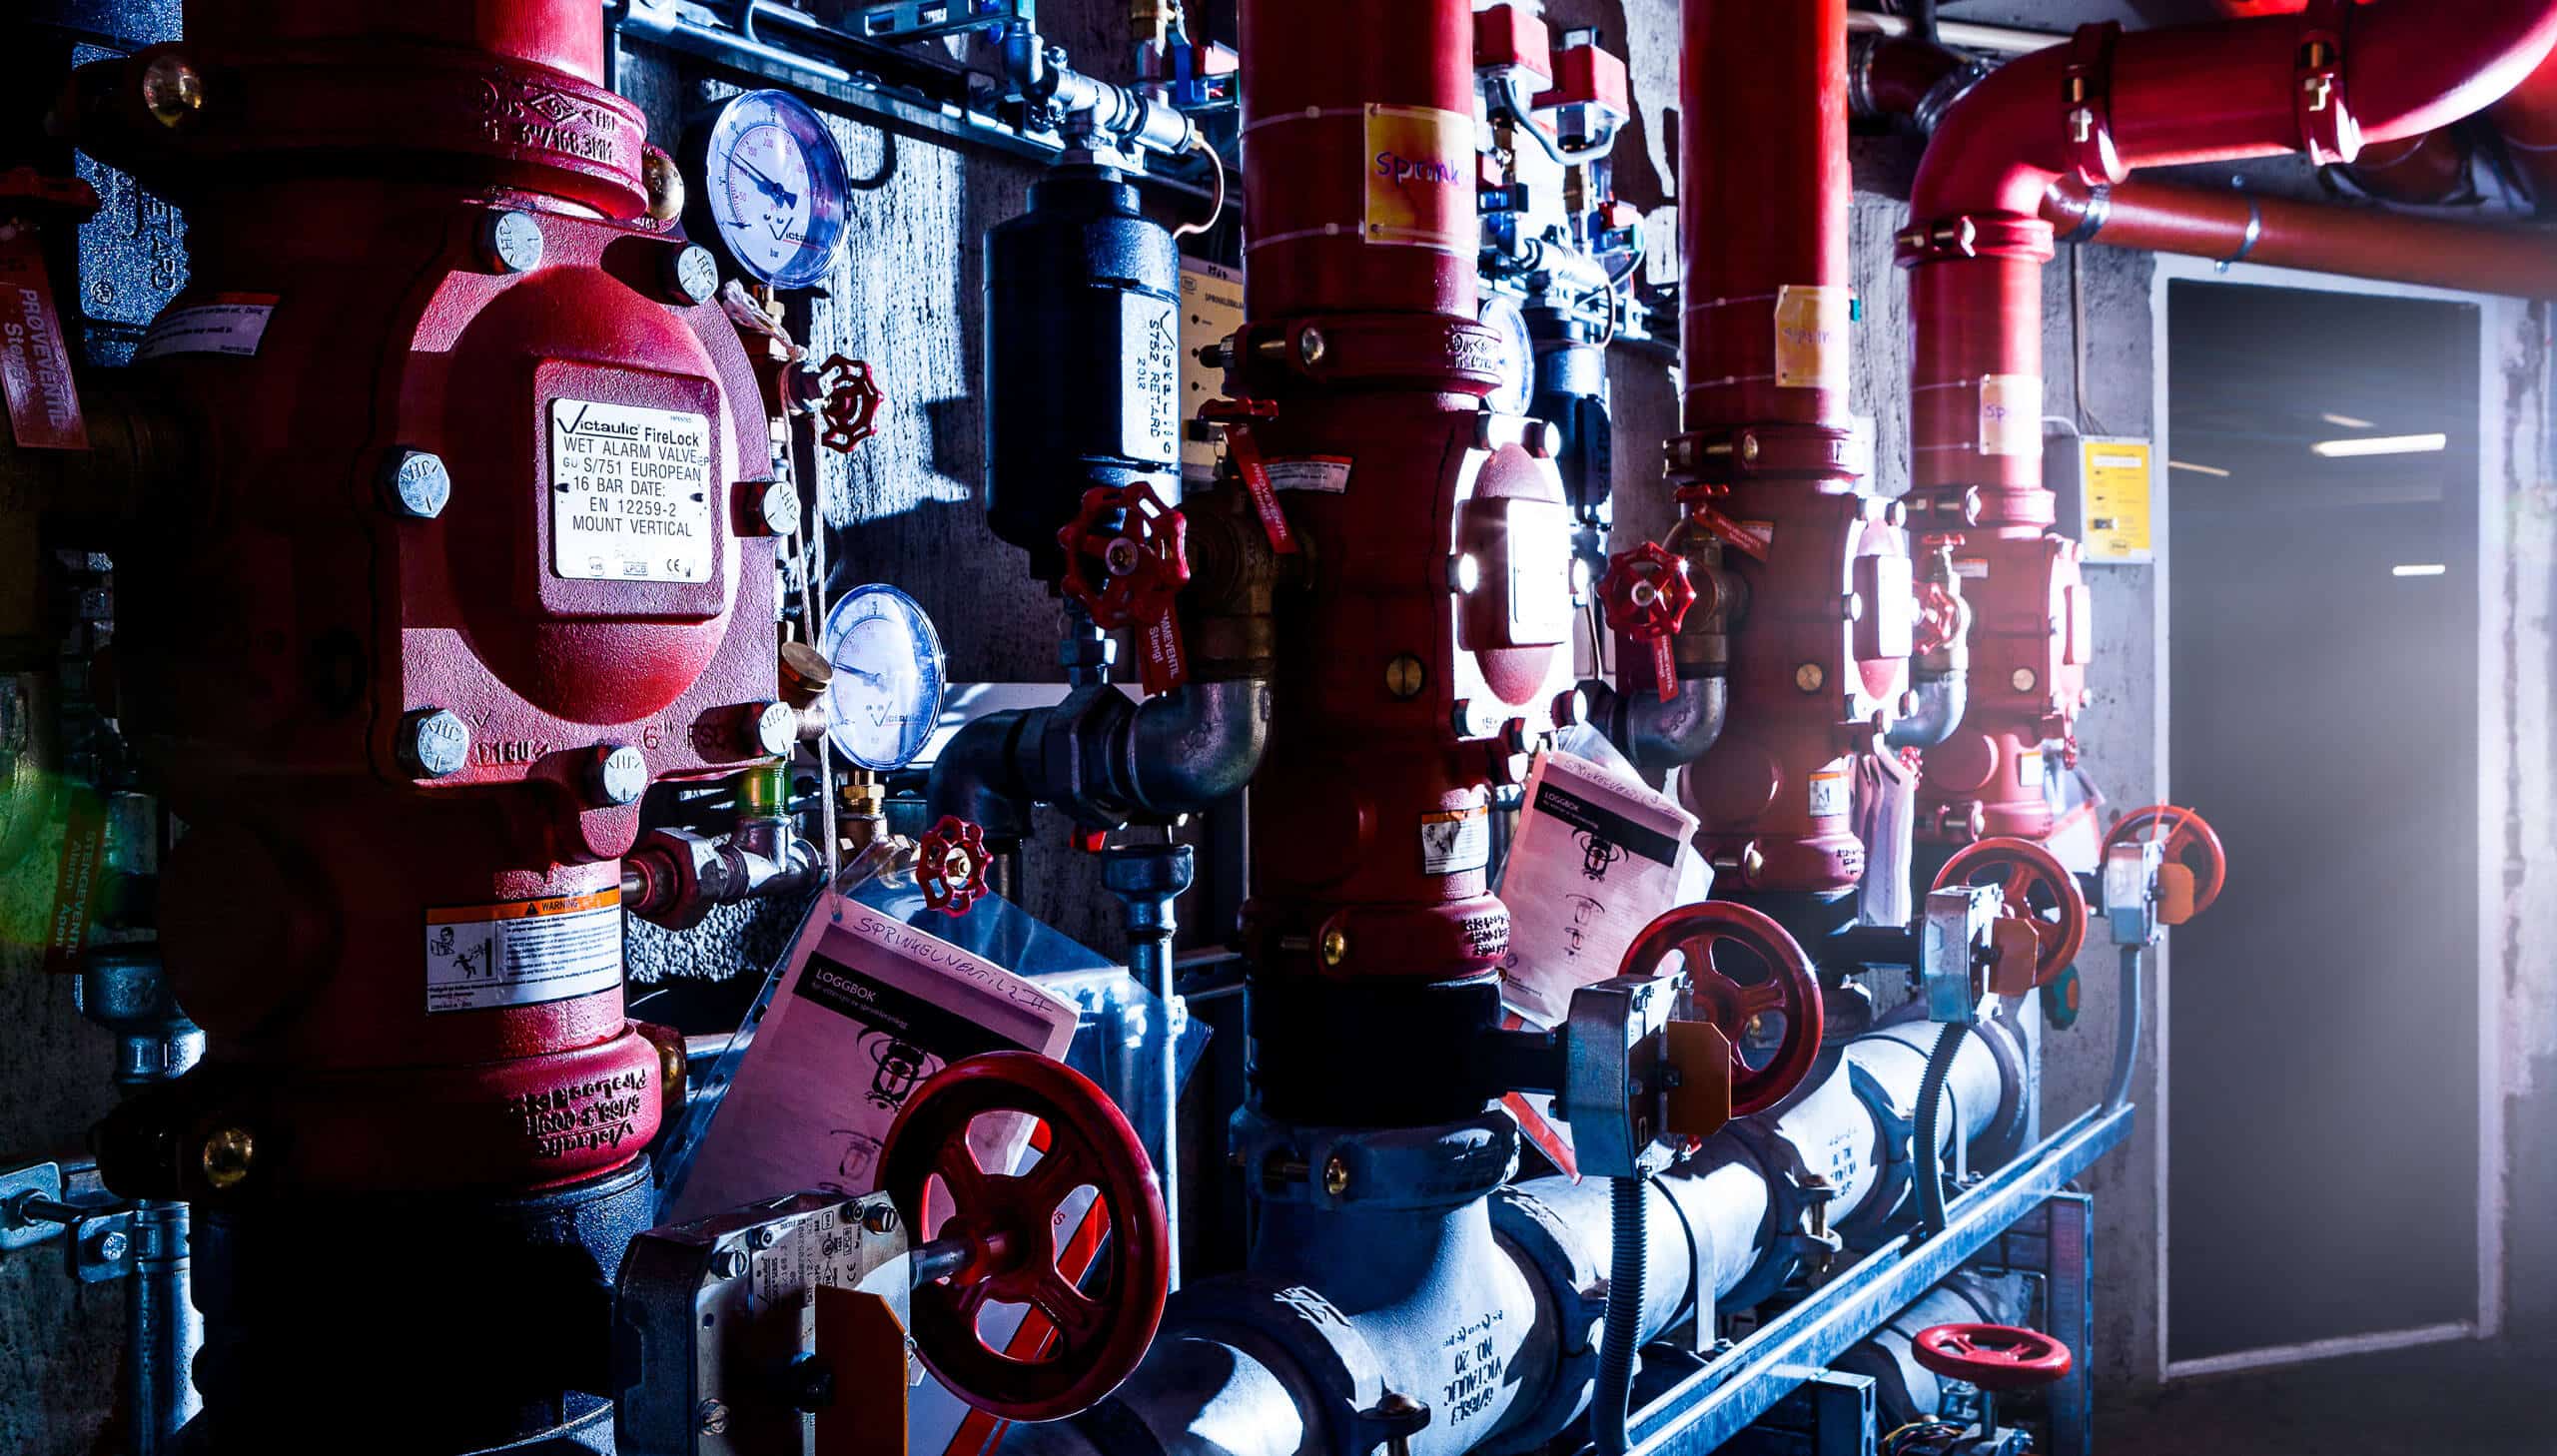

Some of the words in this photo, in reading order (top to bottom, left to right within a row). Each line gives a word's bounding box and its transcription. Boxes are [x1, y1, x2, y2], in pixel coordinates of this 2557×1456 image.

[1137, 358, 1148, 389] 2012
[556, 404, 639, 436] Victaulic
[644, 426, 699, 447] FireLock
[564, 436, 594, 454] WET
[602, 440, 651, 459] ALARM
[658, 446, 697, 464] VALVE
[583, 456, 622, 475] S/751
[631, 461, 701, 481] EUROPEAN
[573, 475, 590, 491] 16
[597, 477, 624, 494] BAR
[631, 480, 666, 498] DATE:
[590, 496, 608, 512] EN
[617, 499, 677, 517] 12259-2
[572, 515, 623, 533] MOUNT
[630, 518, 693, 537] VERTICAL
[541, 898, 578, 913] WARNING
[815, 969, 877, 1001] LOGGBOK
